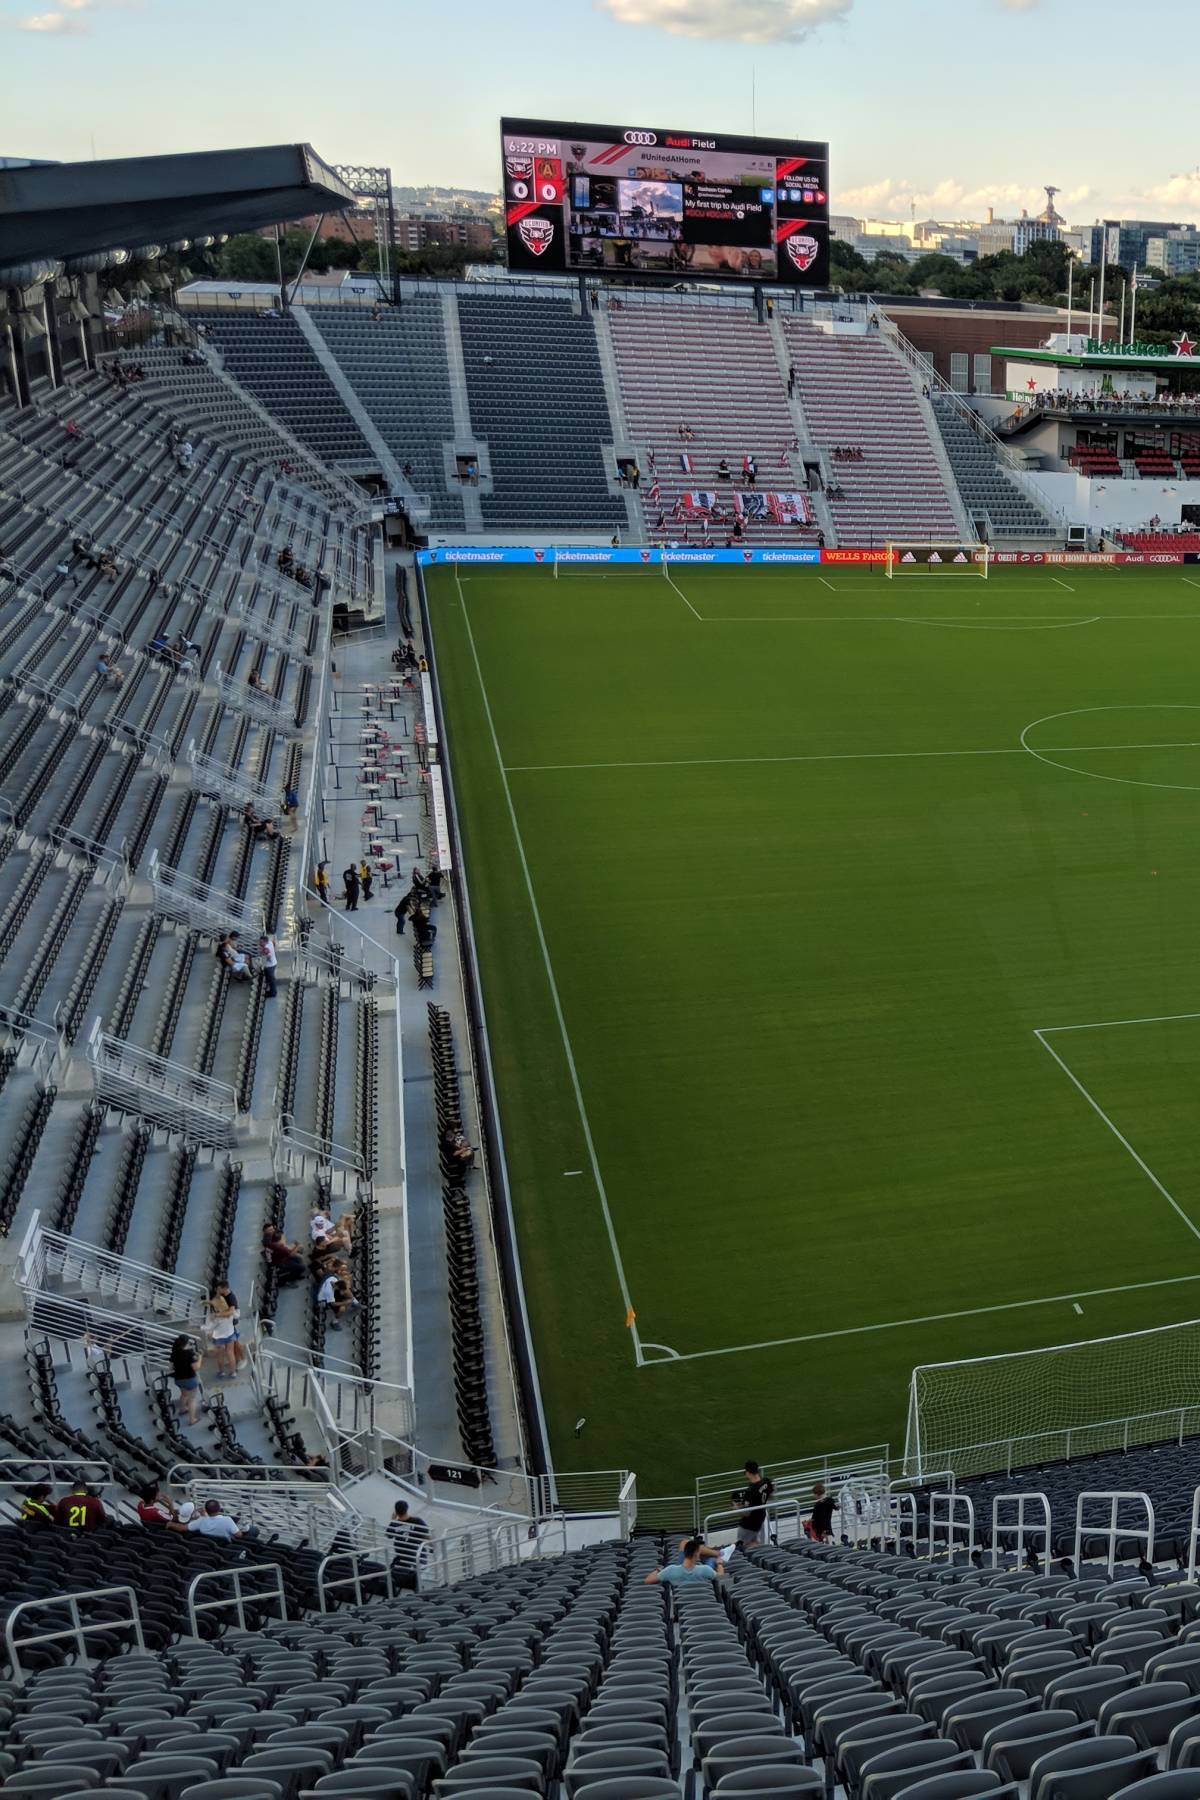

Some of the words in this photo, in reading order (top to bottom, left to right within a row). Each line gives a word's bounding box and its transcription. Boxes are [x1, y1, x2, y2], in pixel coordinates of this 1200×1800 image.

[666, 135, 690, 147] Audi
[692, 139, 716, 149] Field
[508, 141, 535, 154] 6:22
[538, 145, 557, 155] PM
[641, 153, 700, 165] #UnitedAtHome
[783, 175, 803, 183] FOLLOW
[785, 181, 803, 189] SOCIAL
[513, 182, 528, 199] 0
[542, 184, 556, 200] 0
[685, 200, 696, 208] My
[696, 200, 710, 208] first
[710, 201, 722, 210] trip
[730, 203, 745, 211] Audi
[746, 204, 762, 212] Field
[1087, 338, 1169, 358] Heineken
[445, 552, 504, 561] ticketmaster
[555, 552, 611, 561] ticketmaster
[661, 552, 715, 561] ticketmaster
[763, 552, 815, 561] ticketmaster
[826, 552, 859, 561] WELLS
[862, 552, 895, 561] FARGO
[1047, 554, 1064, 562] THE
[1065, 554, 1088, 562] HOME
[1089, 554, 1114, 562] DEPOT
[446, 1469, 462, 1479] 121
[68, 1505, 87, 1527] 21
